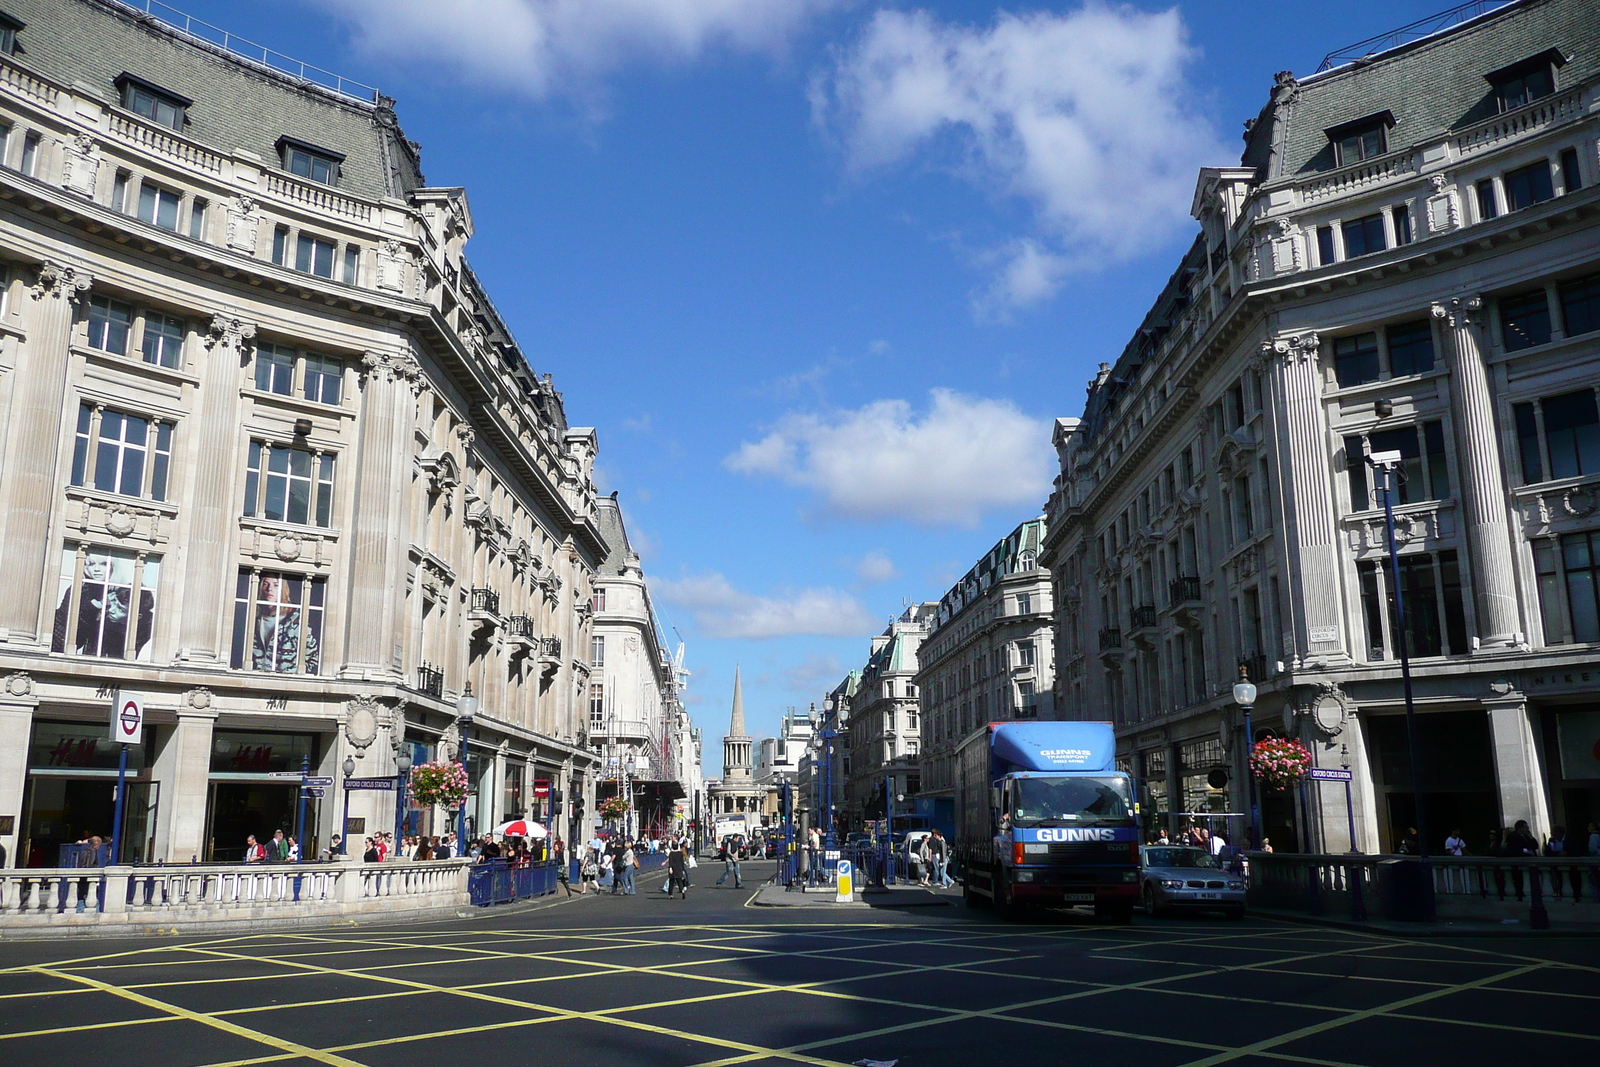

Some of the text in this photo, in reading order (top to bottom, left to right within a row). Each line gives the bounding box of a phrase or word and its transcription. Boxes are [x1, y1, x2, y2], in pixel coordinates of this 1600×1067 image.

[1535, 671, 1600, 685] NIKE
[265, 695, 289, 710] H&M
[48, 738, 98, 767] H&M
[230, 745, 272, 771] H&M
[1326, 770, 1337, 778] CIRCUS
[1338, 771, 1351, 779] STATION
[1036, 829, 1115, 841] GUNNS
